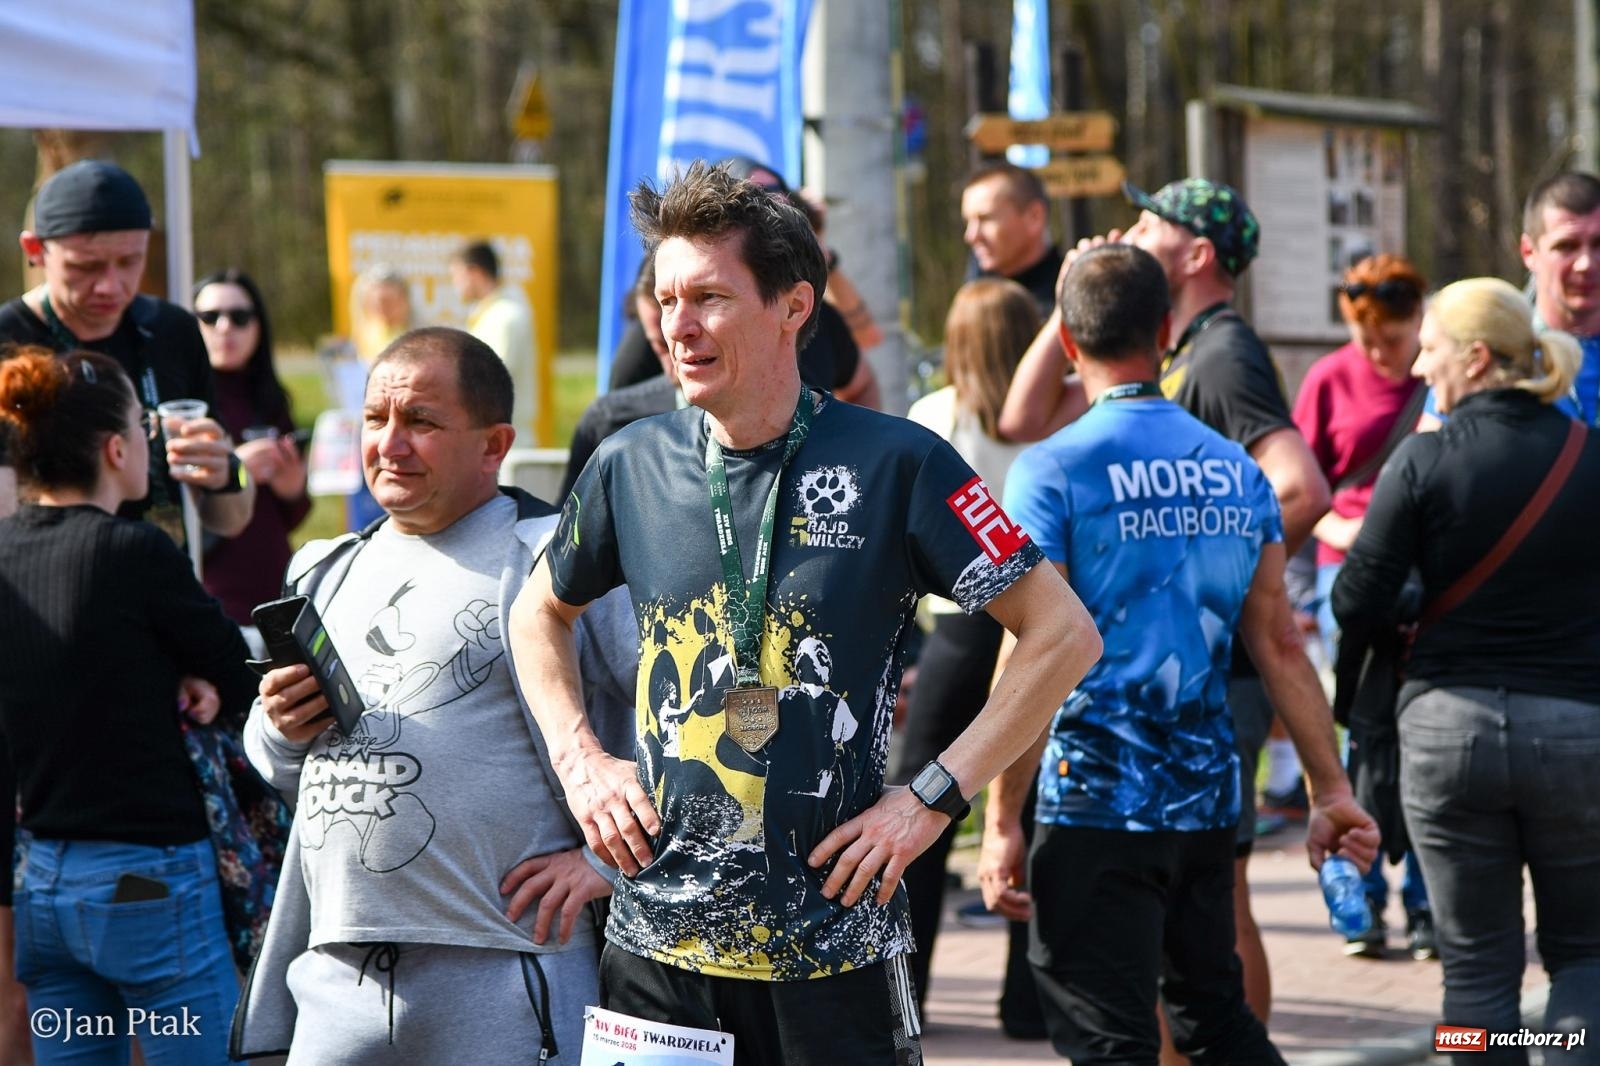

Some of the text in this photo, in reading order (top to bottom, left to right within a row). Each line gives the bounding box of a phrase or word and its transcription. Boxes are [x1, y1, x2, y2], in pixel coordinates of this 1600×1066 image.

[1107, 459, 1244, 502] MORSY
[807, 520, 848, 534] RAJD
[1118, 498, 1254, 542] RACIBÓRZ
[807, 534, 866, 550] WILCZY
[304, 781, 398, 820] DUCK
[595, 1019, 722, 1053] XIV BIEG TWARDZIELA
[599, 1036, 620, 1047] marzec
[620, 1041, 637, 1051] 2026
